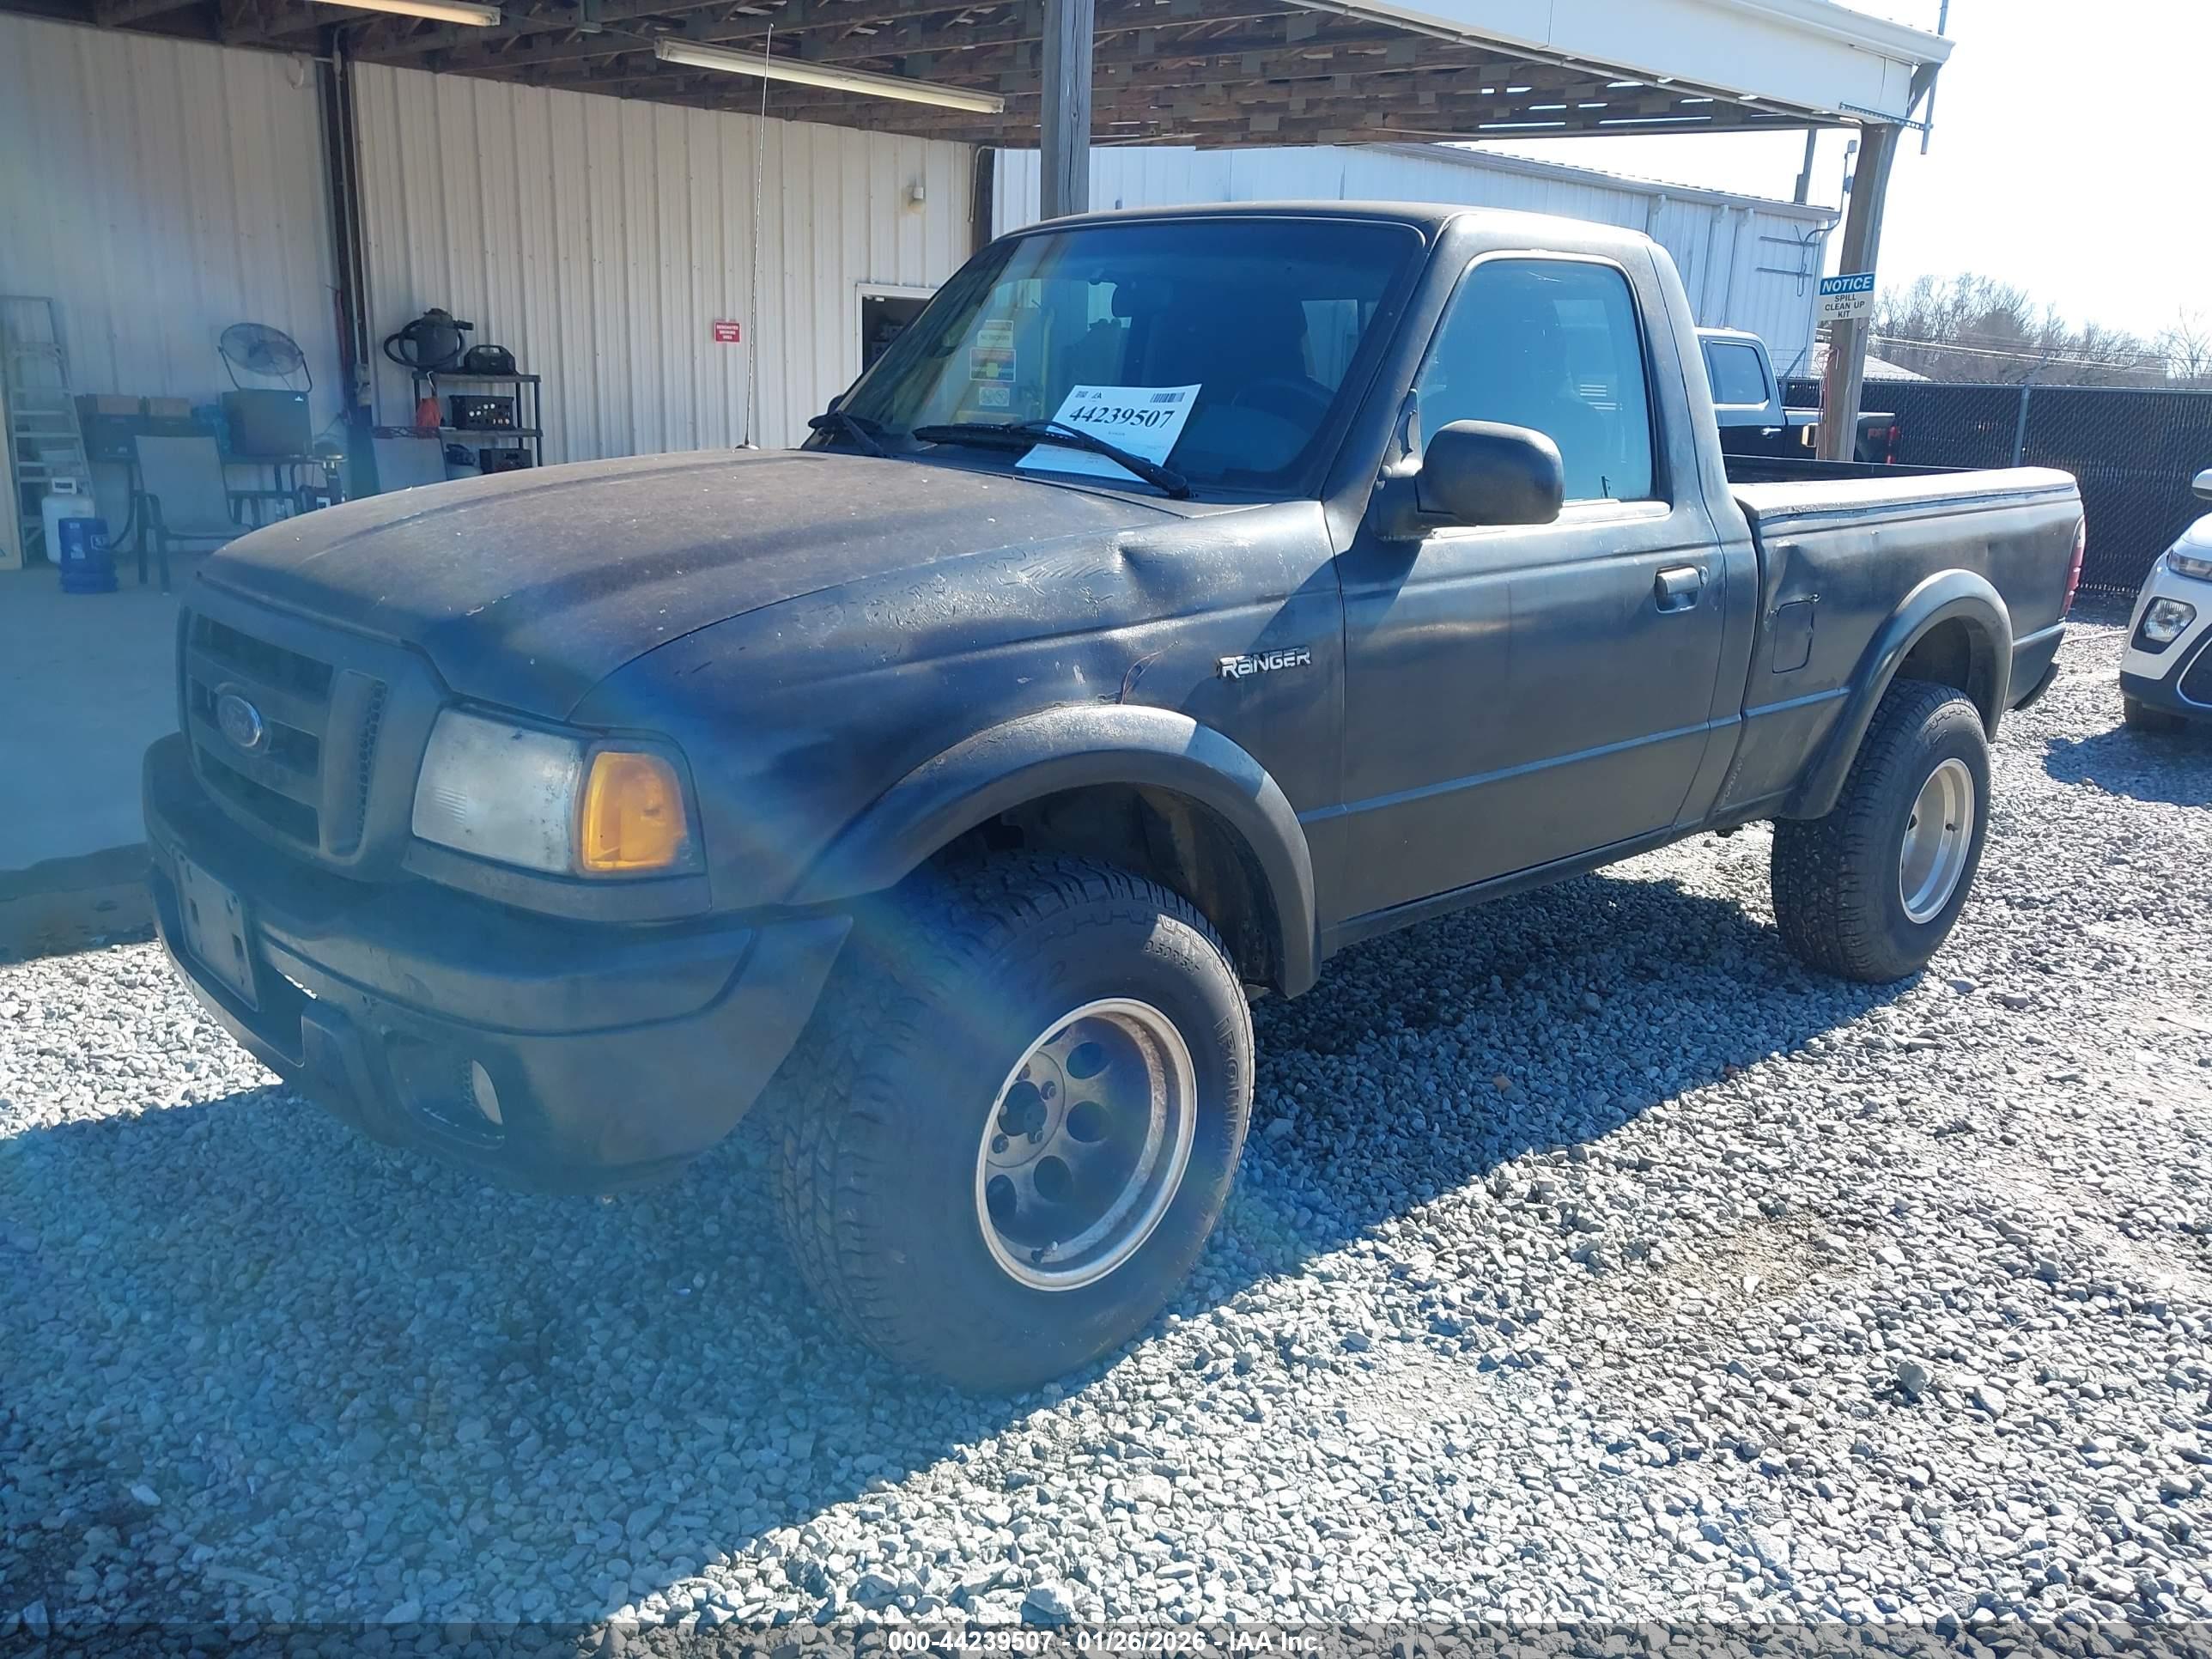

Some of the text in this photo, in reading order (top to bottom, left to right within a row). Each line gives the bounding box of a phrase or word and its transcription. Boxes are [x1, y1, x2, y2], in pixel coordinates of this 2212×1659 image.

[1821, 276, 1873, 294] NOTICE
[1834, 293, 1856, 302] SPILL
[1825, 301, 1865, 311] CLEAN UP
[1838, 310, 1850, 319] KIT
[1069, 405, 1175, 428] 44239507
